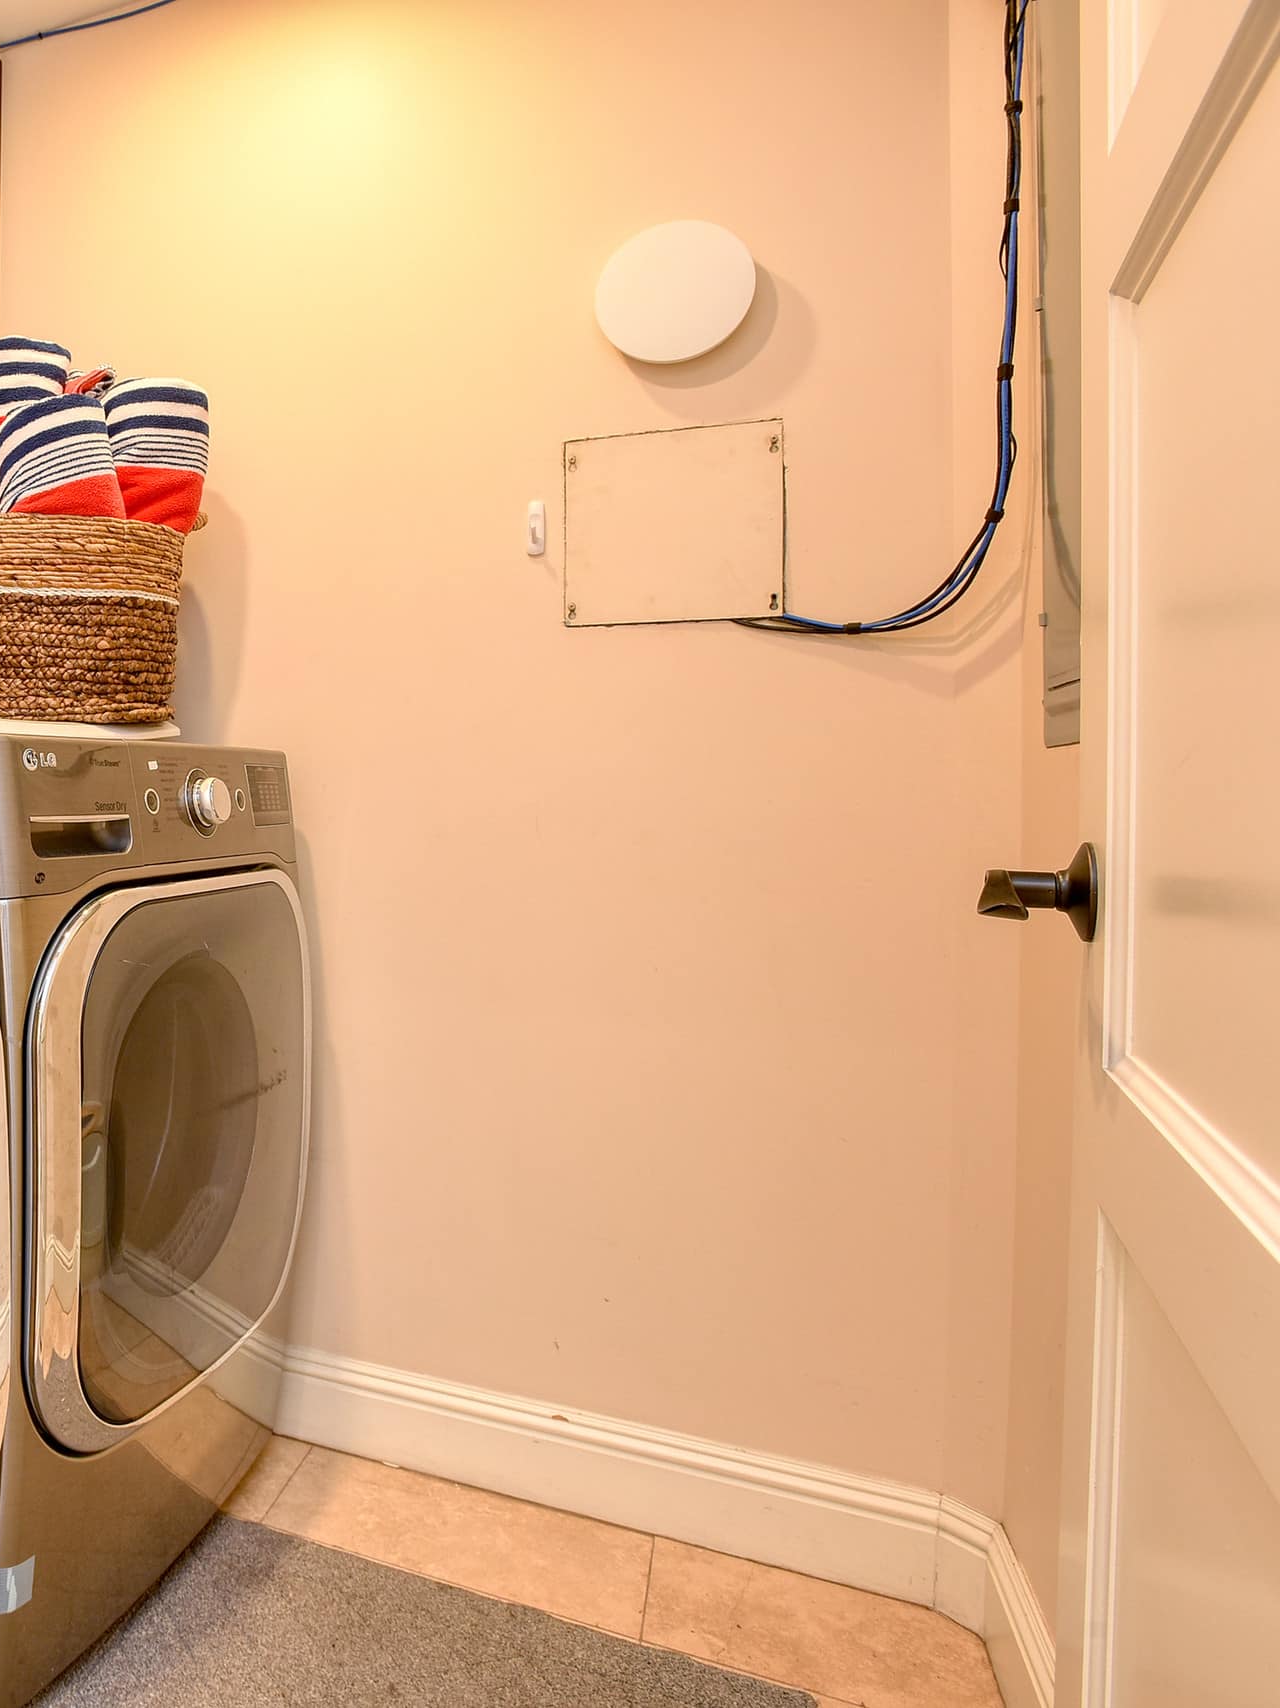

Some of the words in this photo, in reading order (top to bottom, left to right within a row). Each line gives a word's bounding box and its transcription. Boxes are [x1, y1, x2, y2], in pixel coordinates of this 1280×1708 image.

[39, 752, 57, 768] LG
[94, 801, 116, 811] Sensor
[116, 801, 127, 812] Dry
